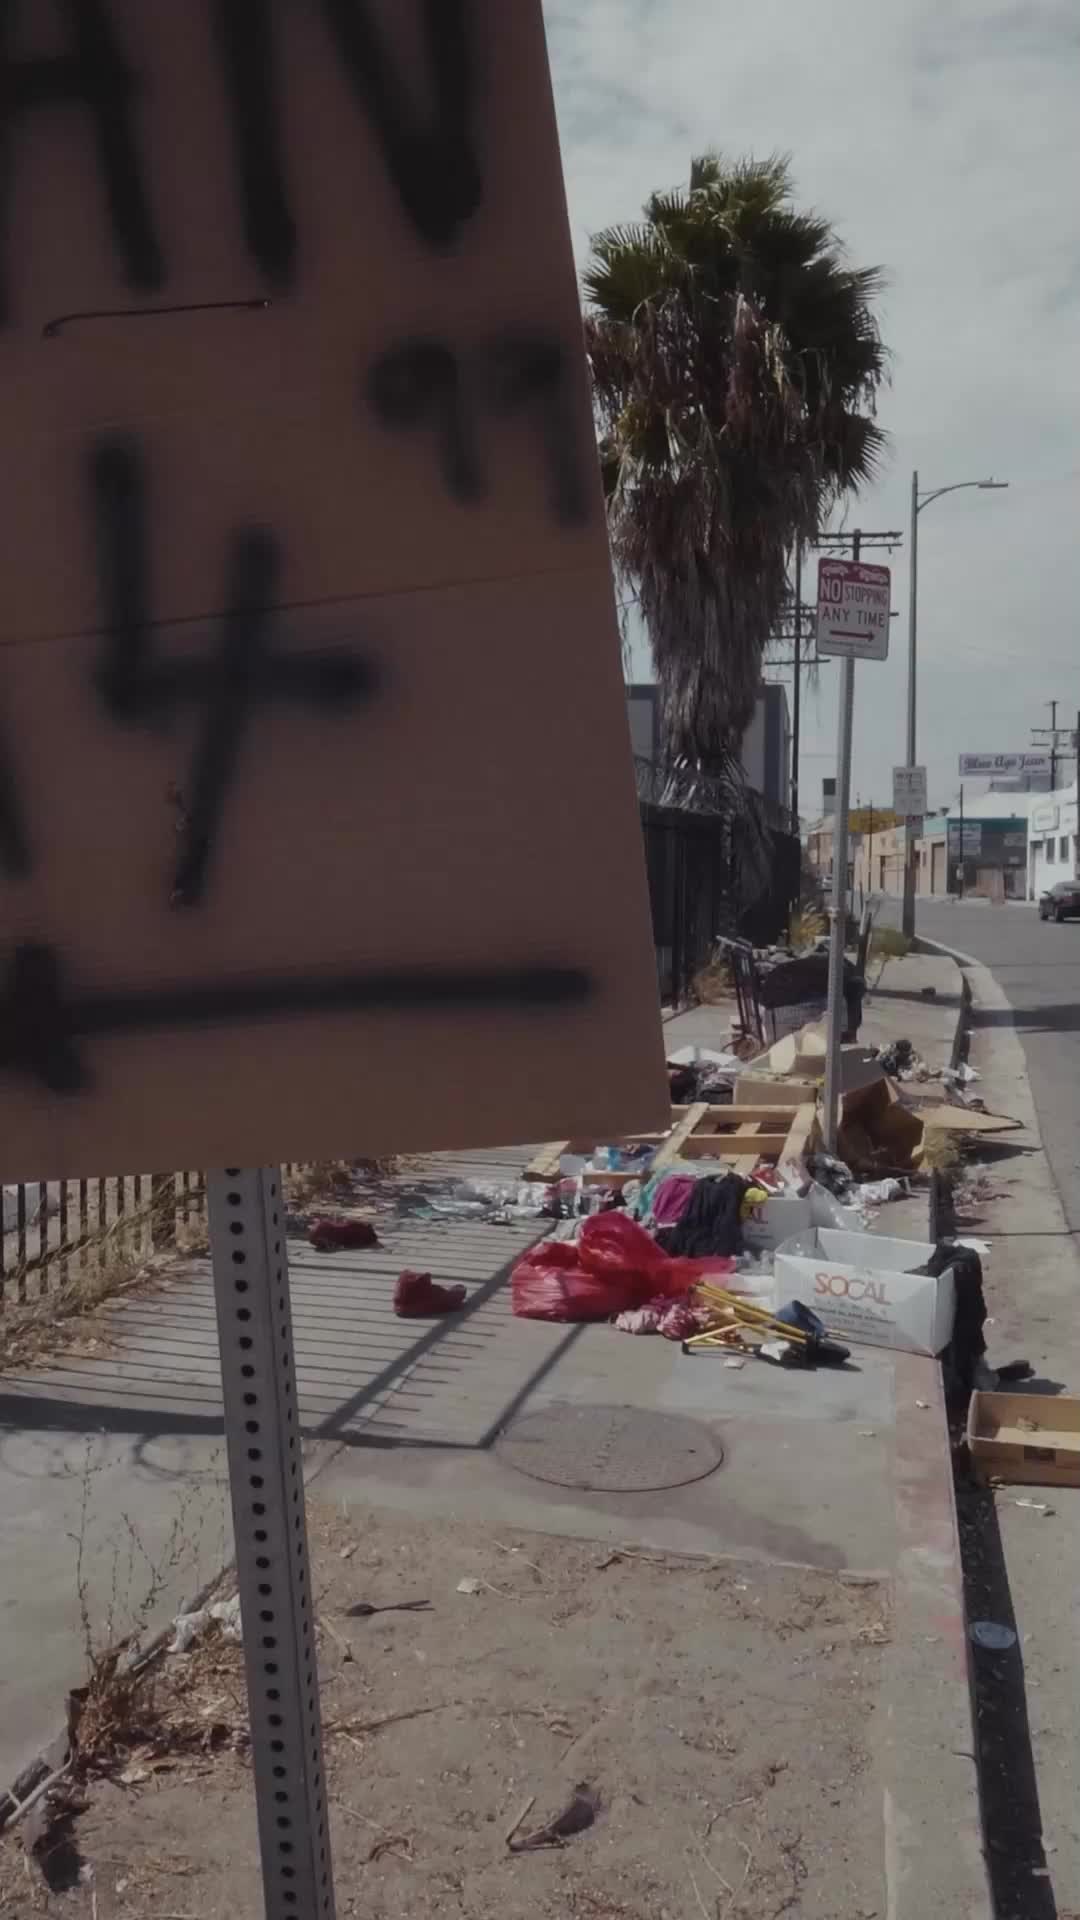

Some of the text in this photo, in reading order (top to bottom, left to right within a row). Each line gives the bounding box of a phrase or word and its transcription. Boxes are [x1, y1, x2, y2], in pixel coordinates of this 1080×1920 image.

[820, 577, 888, 607] NO STOPPING
[822, 606, 886, 628] ANY TIME
[815, 1272, 892, 1306] SOCAL
